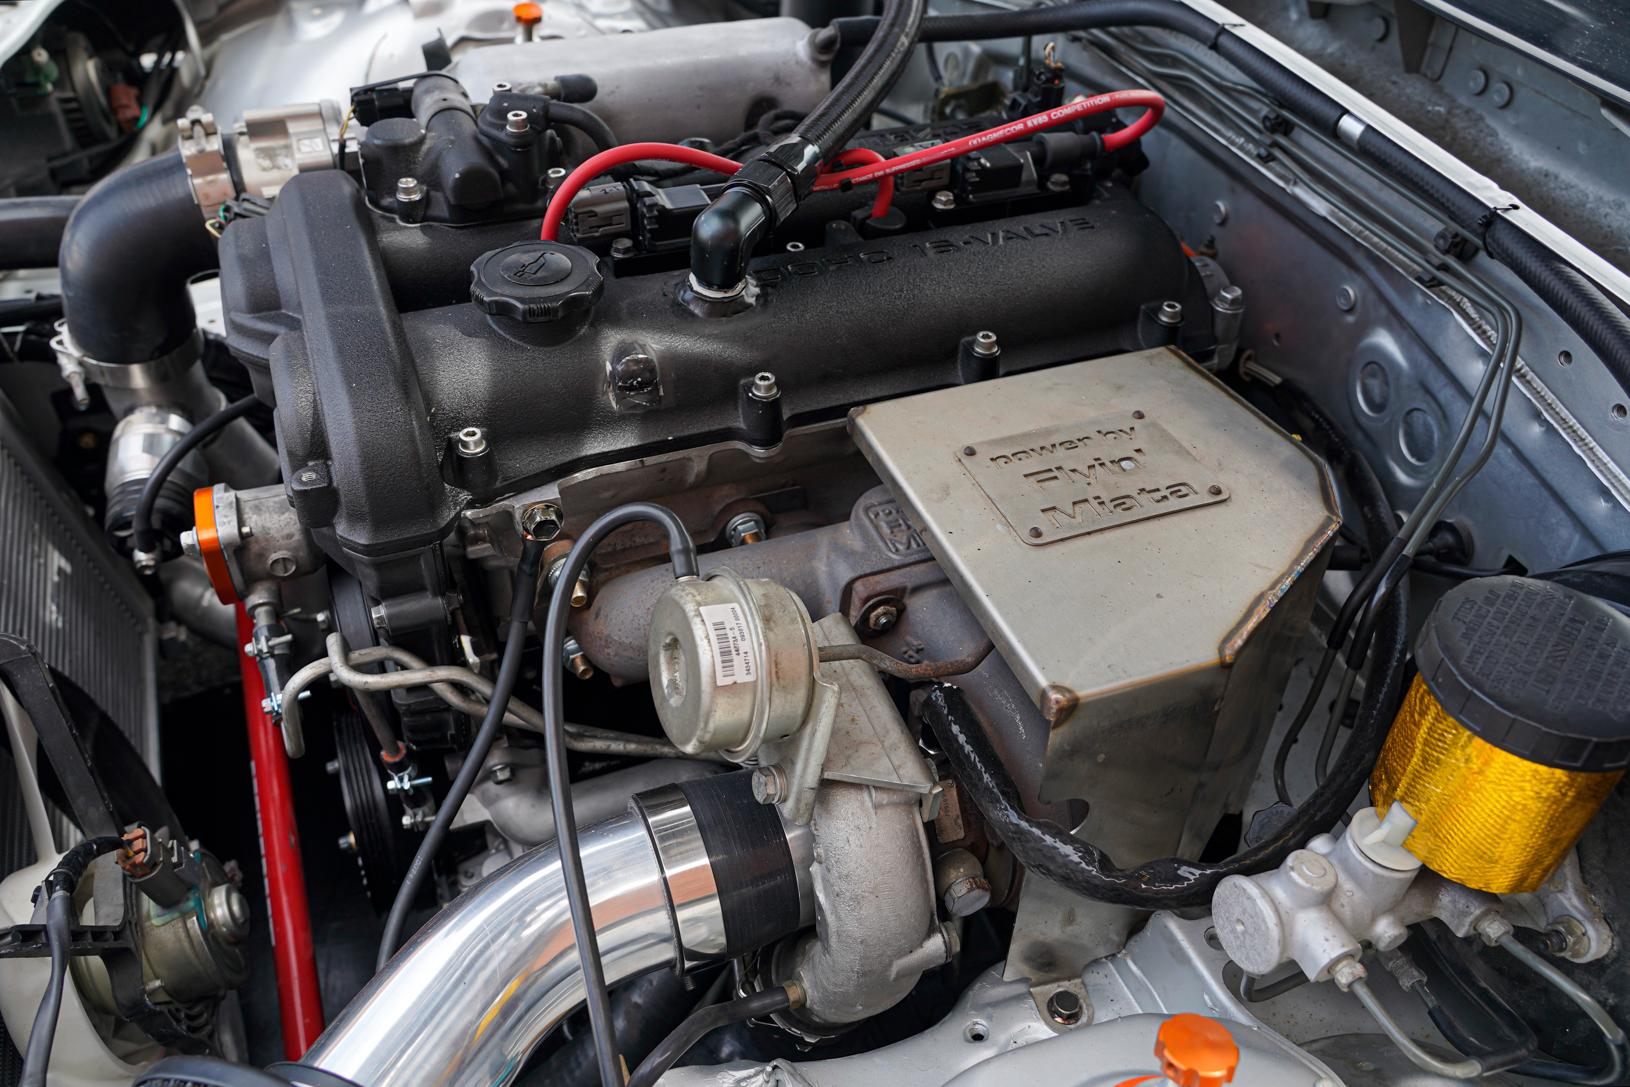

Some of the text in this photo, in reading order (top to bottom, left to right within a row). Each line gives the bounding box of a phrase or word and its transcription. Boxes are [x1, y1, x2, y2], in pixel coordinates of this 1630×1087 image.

[1050, 95, 1111, 119] COMPETITION
[910, 217, 1096, 257] 16-VALVE
[989, 426, 1136, 472] power by
[1022, 448, 1146, 492] Flyin'
[1040, 481, 1200, 529] Miata
